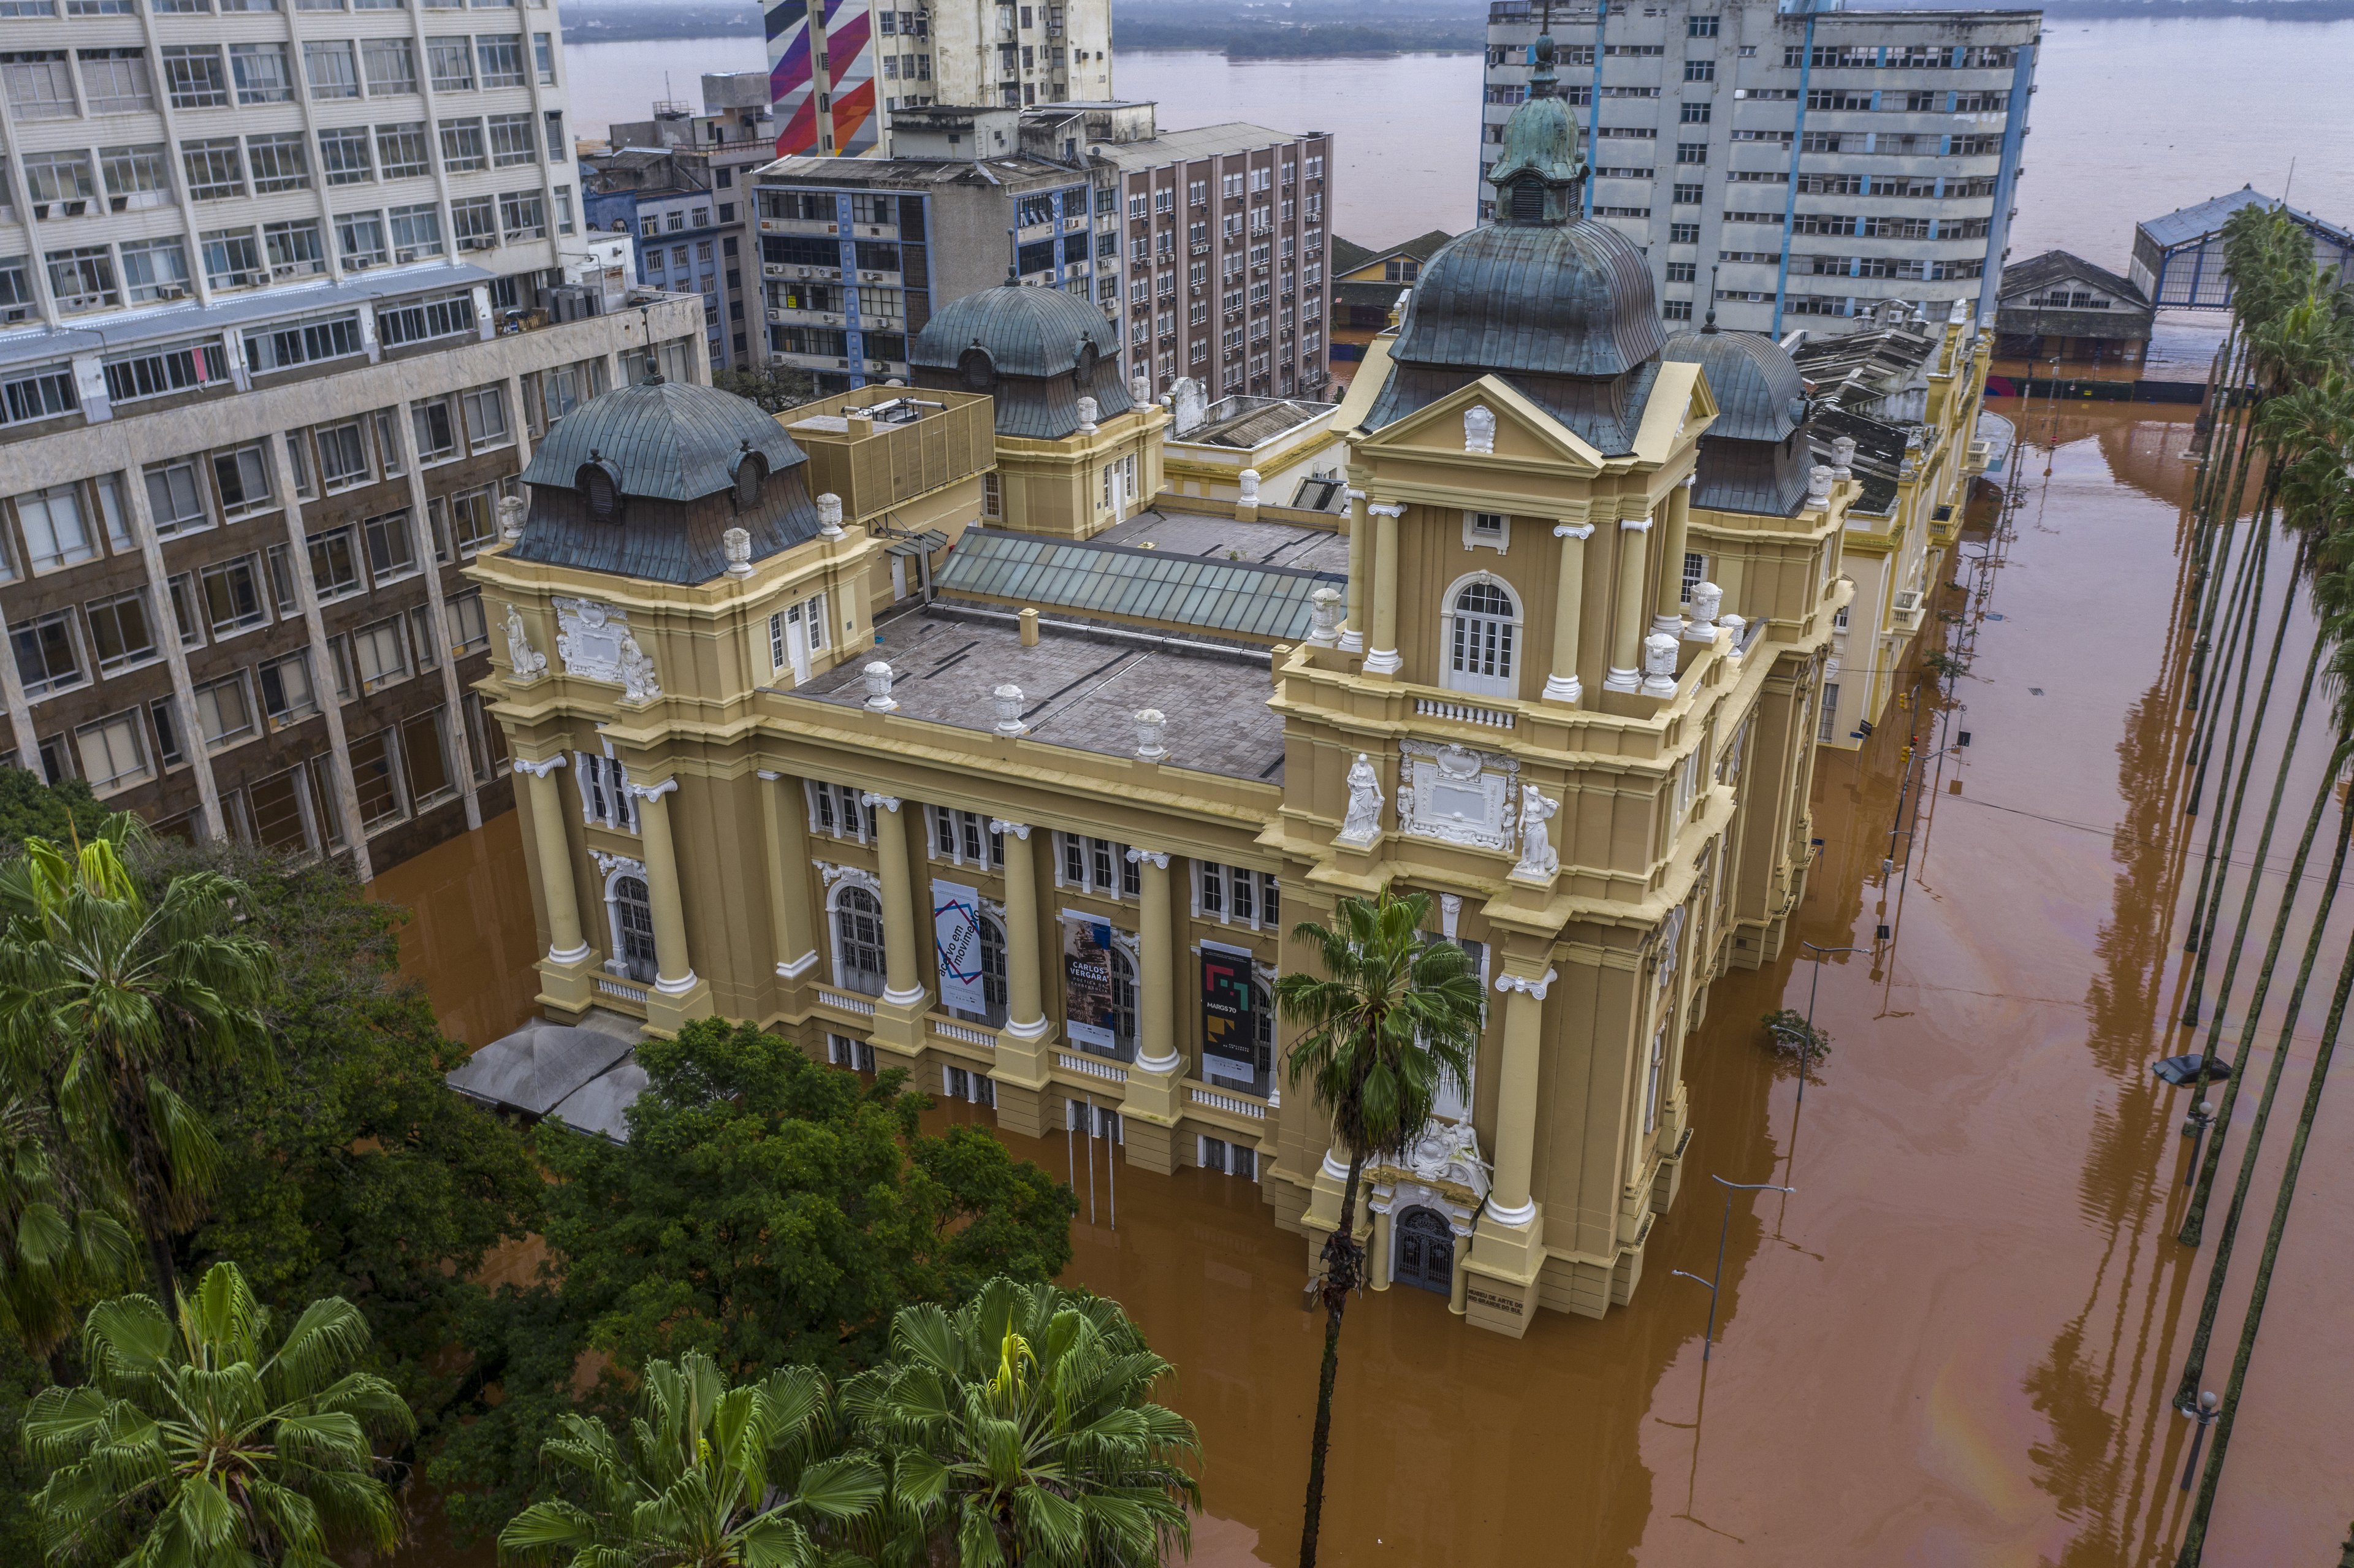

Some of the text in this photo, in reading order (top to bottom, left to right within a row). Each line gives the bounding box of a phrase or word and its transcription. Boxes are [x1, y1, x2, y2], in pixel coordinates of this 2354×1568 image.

[954, 910, 980, 966] movimento
[939, 925, 964, 976] acervo em
[1070, 967, 1108, 982] VERGARA
[1073, 961, 1104, 974] CARLOS
[1207, 1002, 1228, 1011] MARGS
[1468, 1289, 1487, 1298] MUSEU
[1498, 1298, 1514, 1306] ARTE
[1478, 1298, 1501, 1309] GRANDE
